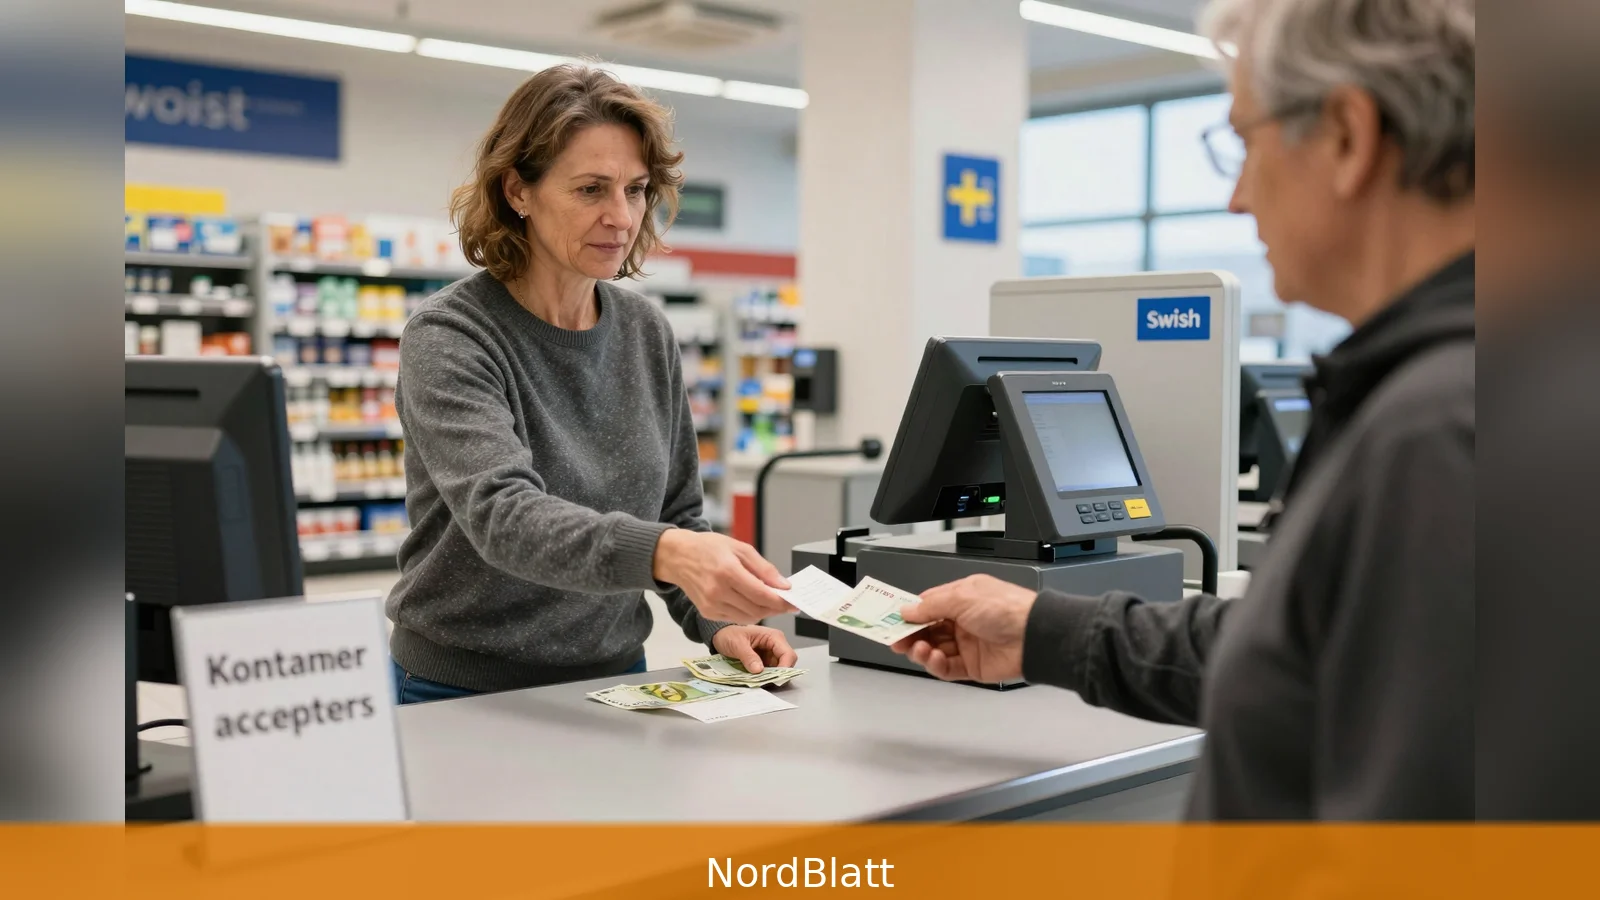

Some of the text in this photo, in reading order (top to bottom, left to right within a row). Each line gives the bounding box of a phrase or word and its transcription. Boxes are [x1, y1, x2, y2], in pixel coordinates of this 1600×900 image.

[1146, 307, 1201, 329] Swish
[206, 647, 367, 686] Kontamer
[215, 696, 376, 738] accepters
